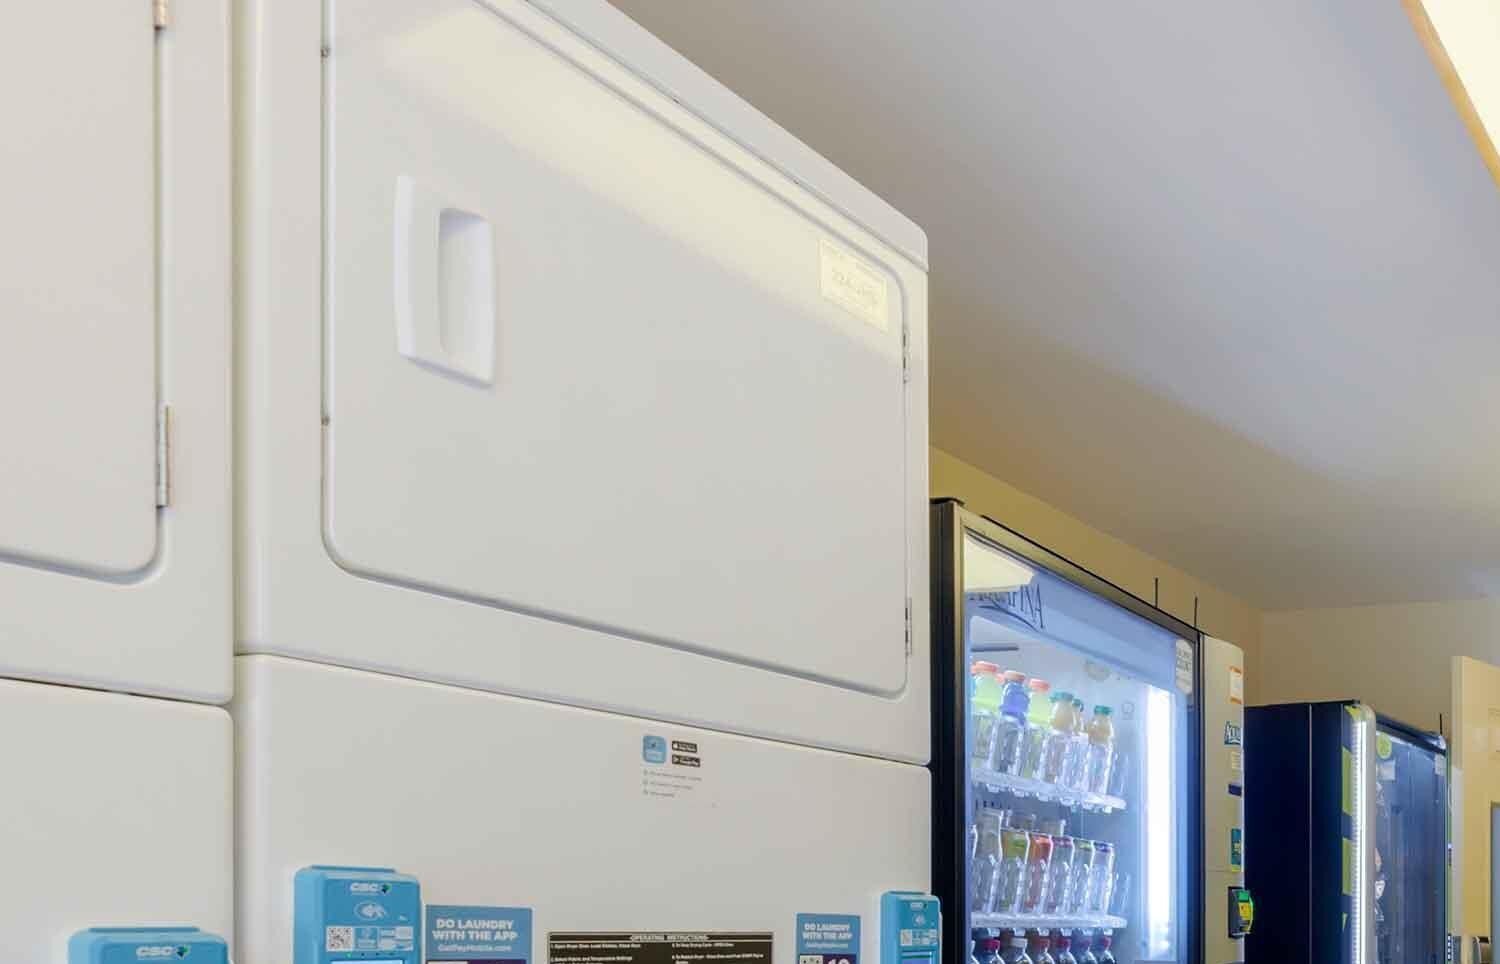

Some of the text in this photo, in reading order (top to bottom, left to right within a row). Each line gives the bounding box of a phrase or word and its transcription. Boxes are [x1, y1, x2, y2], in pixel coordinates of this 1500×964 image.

[436, 918, 513, 930] DO LAUNDRY
[817, 923, 850, 931] LAUNDRY
[432, 930, 518, 942] WITH THE APP
